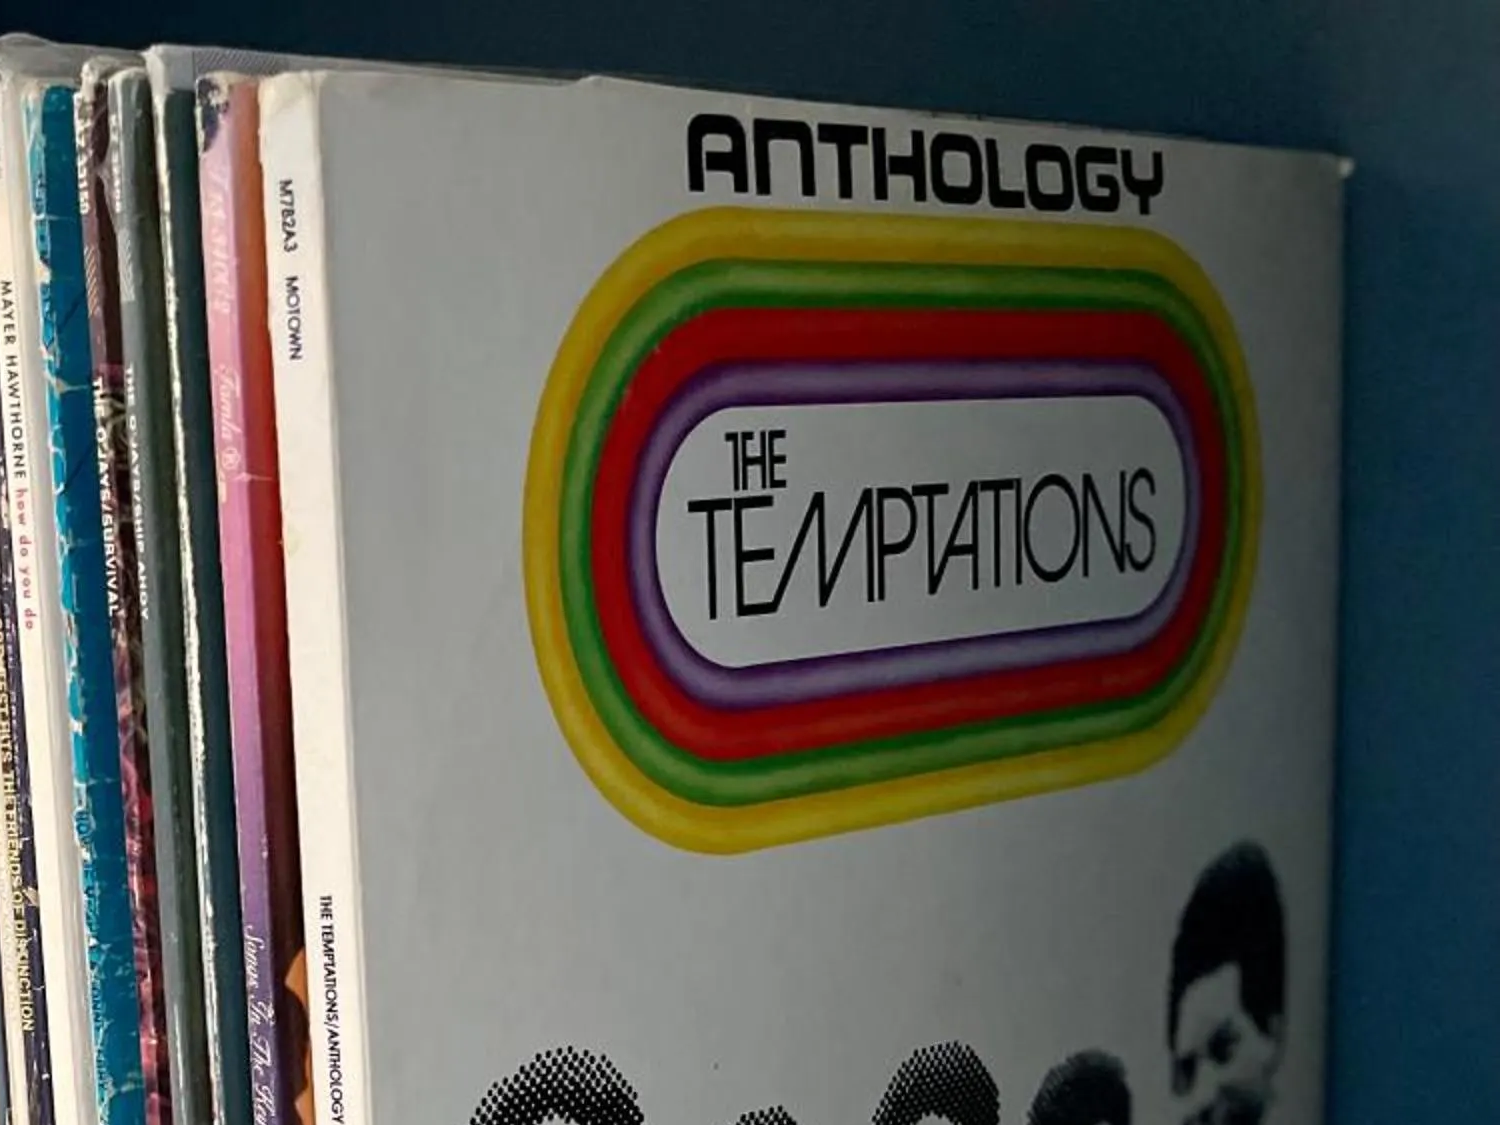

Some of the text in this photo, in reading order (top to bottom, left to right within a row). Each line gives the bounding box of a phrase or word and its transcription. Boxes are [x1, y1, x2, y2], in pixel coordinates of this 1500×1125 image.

[687, 113, 1165, 215] ANTHOLOGY
[285, 275, 303, 361] MOTOWN
[0, 280, 37, 631] MAYER HAWTHORNE how do you do
[125, 366, 135, 406] THE
[138, 561, 150, 621] AHOY
[723, 429, 787, 492] THE
[92, 375, 120, 618] THE O'JAYS/SURVIVAL
[687, 467, 1158, 621] TEMPTATIONS
[3, 768, 18, 806] THE
[5, 808, 23, 887] FRIENDS
[11, 889, 26, 918] OF
[319, 893, 334, 921] THE
[245, 924, 266, 992] Songs
[250, 993, 270, 1028] In
[320, 921, 346, 1125] TEMPTATIONS/ANTHOLOGY
[250, 1030, 273, 1078] The
